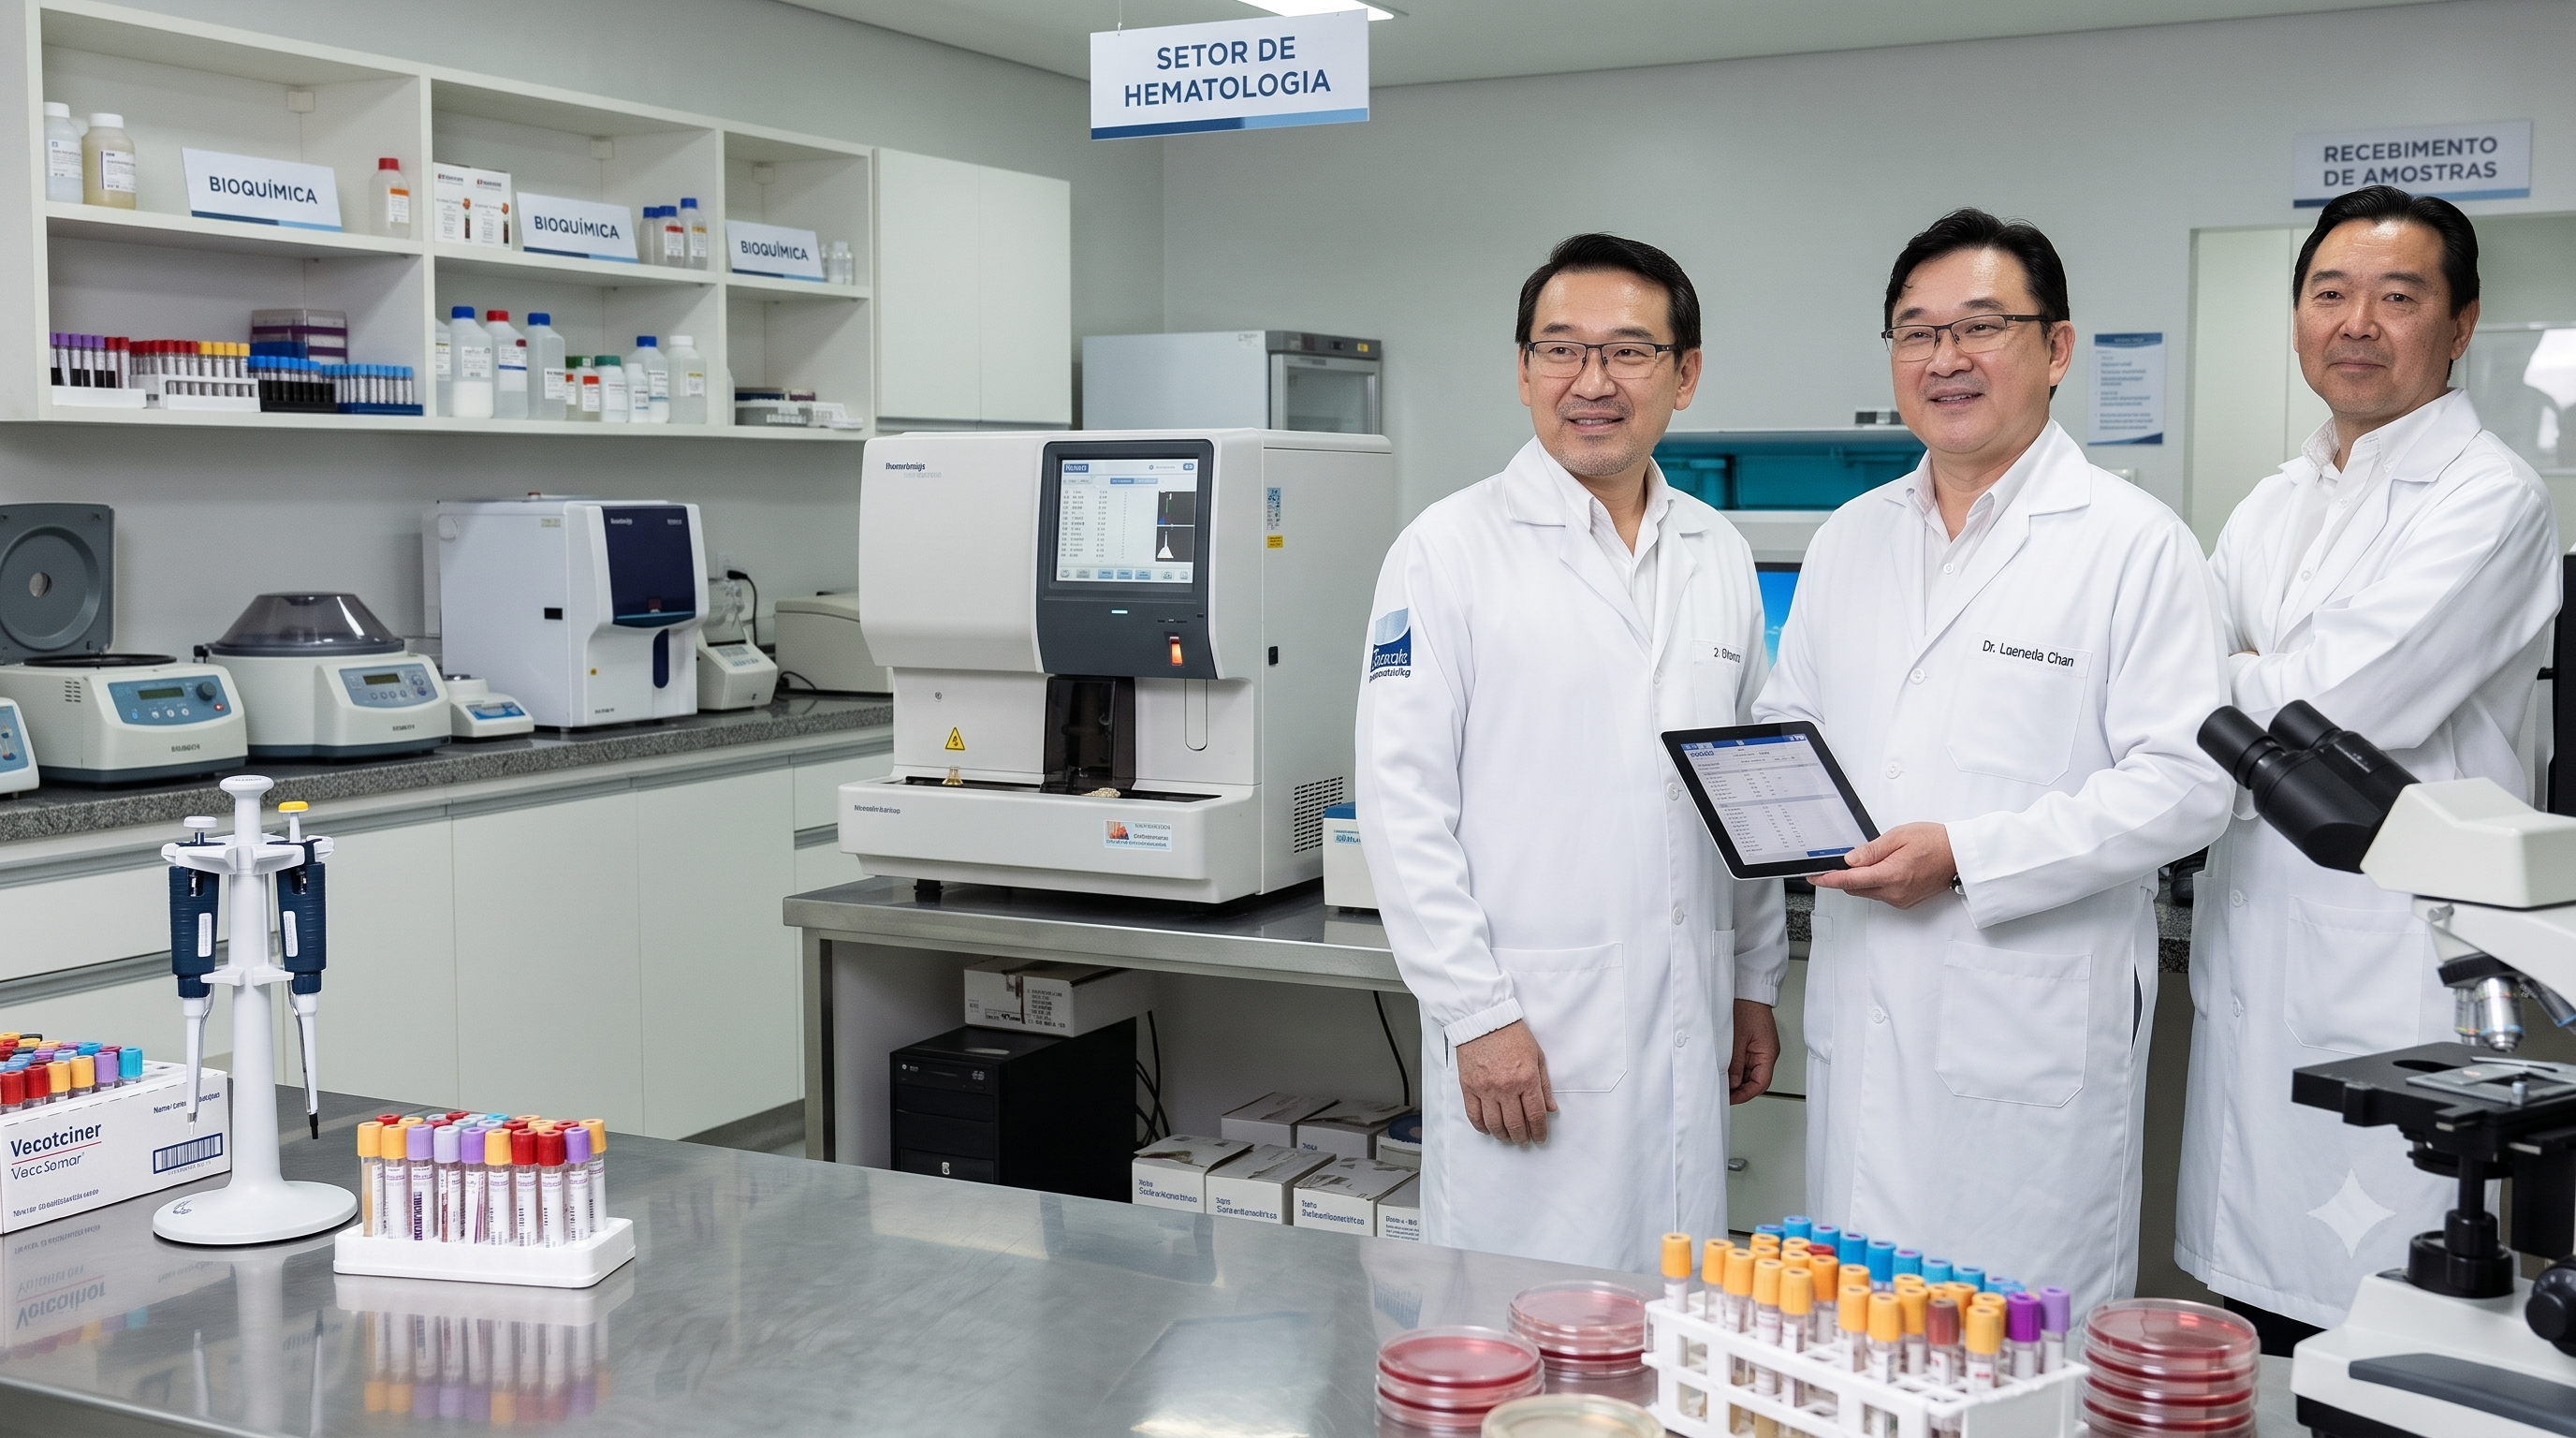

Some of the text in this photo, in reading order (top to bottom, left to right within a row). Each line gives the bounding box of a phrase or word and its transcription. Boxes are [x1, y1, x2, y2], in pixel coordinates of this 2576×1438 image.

[1156, 36, 1295, 70] SETOR DE
[1124, 68, 1331, 108] HEMATOLOGIA
[2323, 136, 2498, 163] RECEBIMENTO
[2323, 161, 2497, 186] DE AMOSTRAS
[209, 175, 318, 204] BIOQUÍMICA
[534, 215, 620, 240] BIOQUÍMICA
[740, 240, 810, 261] BIOQUÍMICA
[1983, 639, 1996, 653] Dr.
[2047, 652, 2074, 667] Chan
[10, 1123, 102, 1157] Vecotciner
